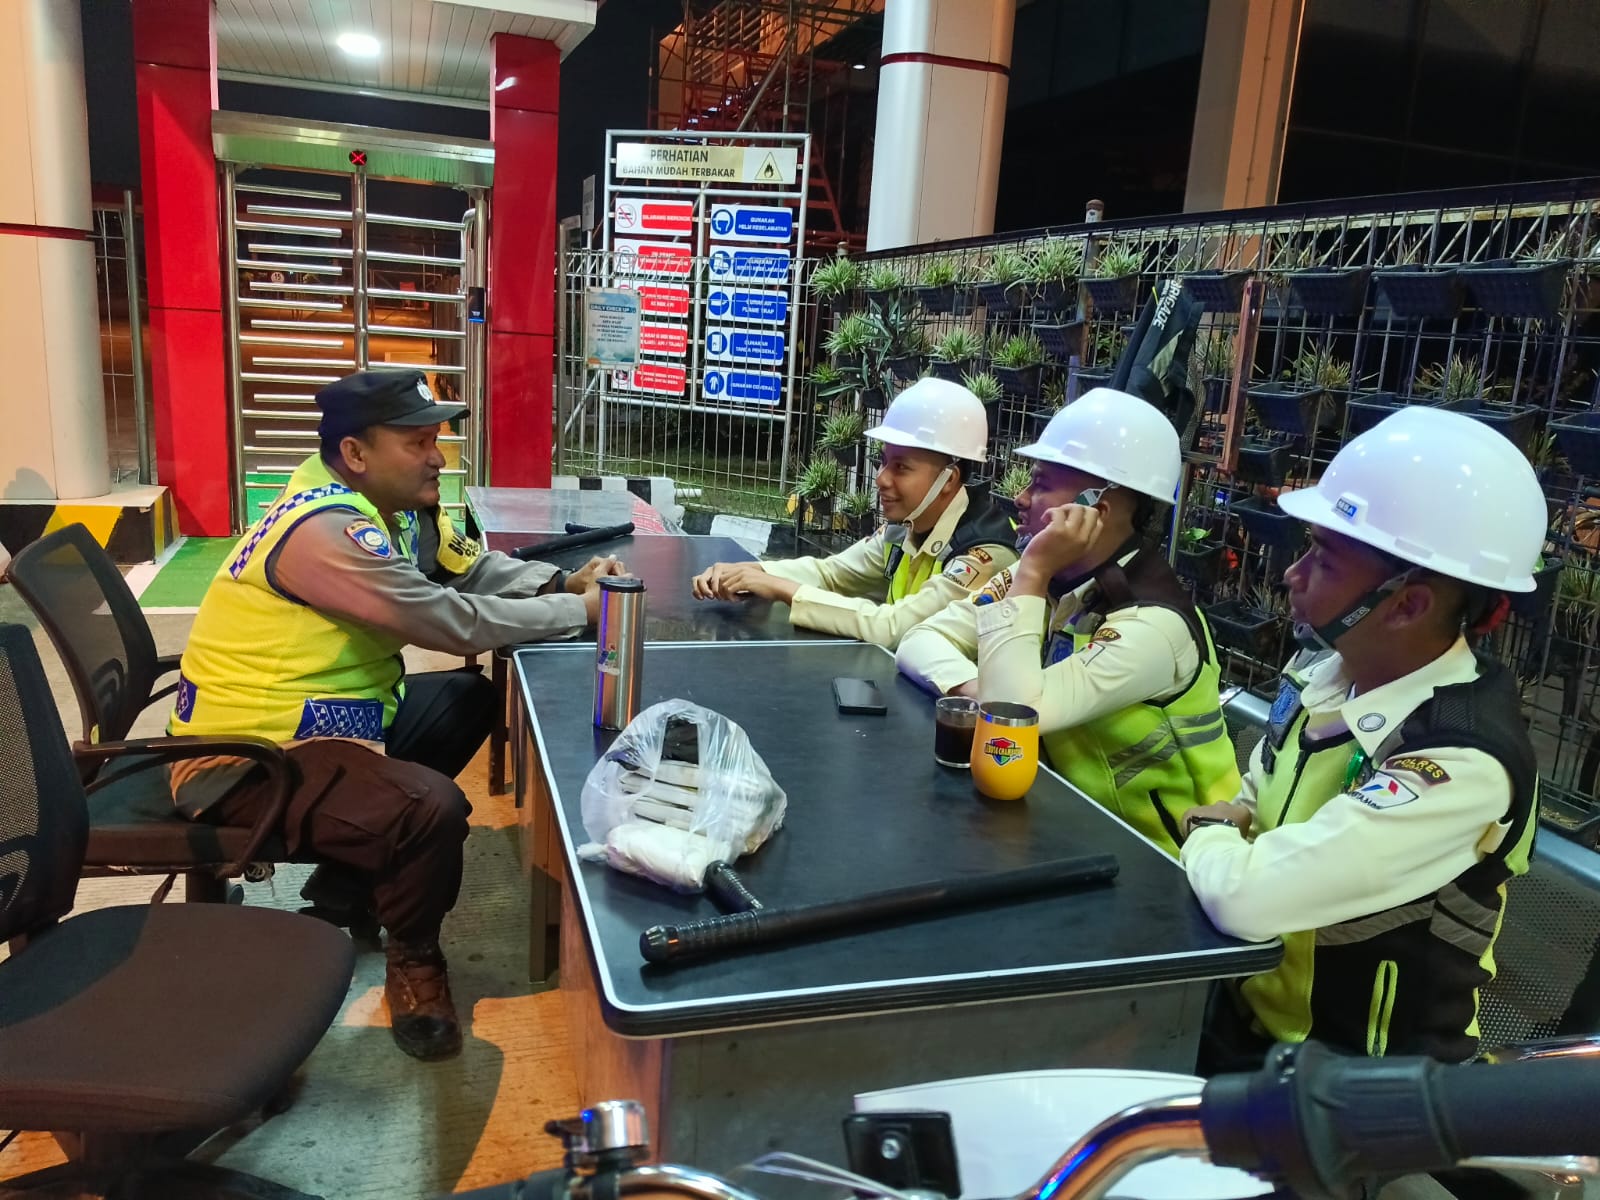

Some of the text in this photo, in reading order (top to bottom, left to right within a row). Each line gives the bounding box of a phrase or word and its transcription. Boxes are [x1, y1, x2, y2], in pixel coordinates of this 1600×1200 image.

[650, 149, 709, 163] PERHATIAN
[622, 166, 735, 178] BAHAN MUDAH TERBAKAR
